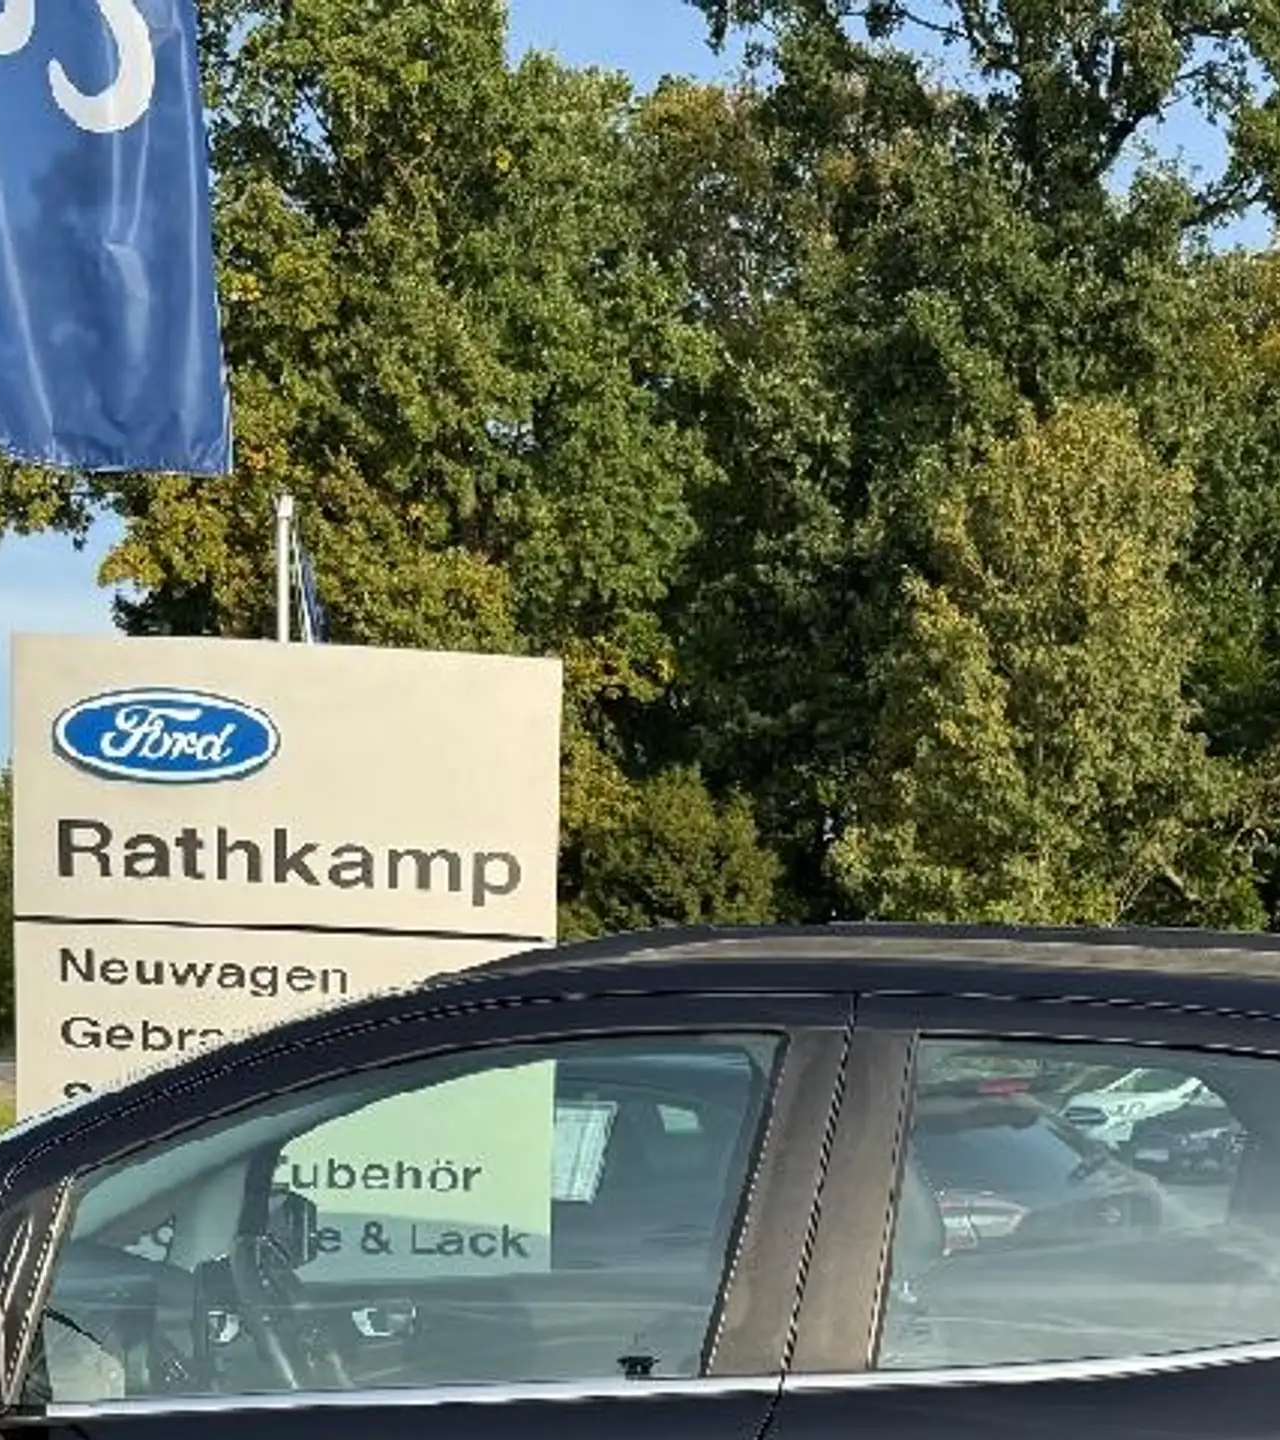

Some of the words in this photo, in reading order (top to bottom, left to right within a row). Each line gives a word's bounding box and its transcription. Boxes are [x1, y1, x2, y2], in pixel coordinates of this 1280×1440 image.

[99, 704, 238, 764] Ford
[56, 818, 523, 907] Rathkamp
[59, 947, 349, 998] Neuwagen
[360, 1220, 393, 1255] &
[410, 1223, 533, 1259] Lack
